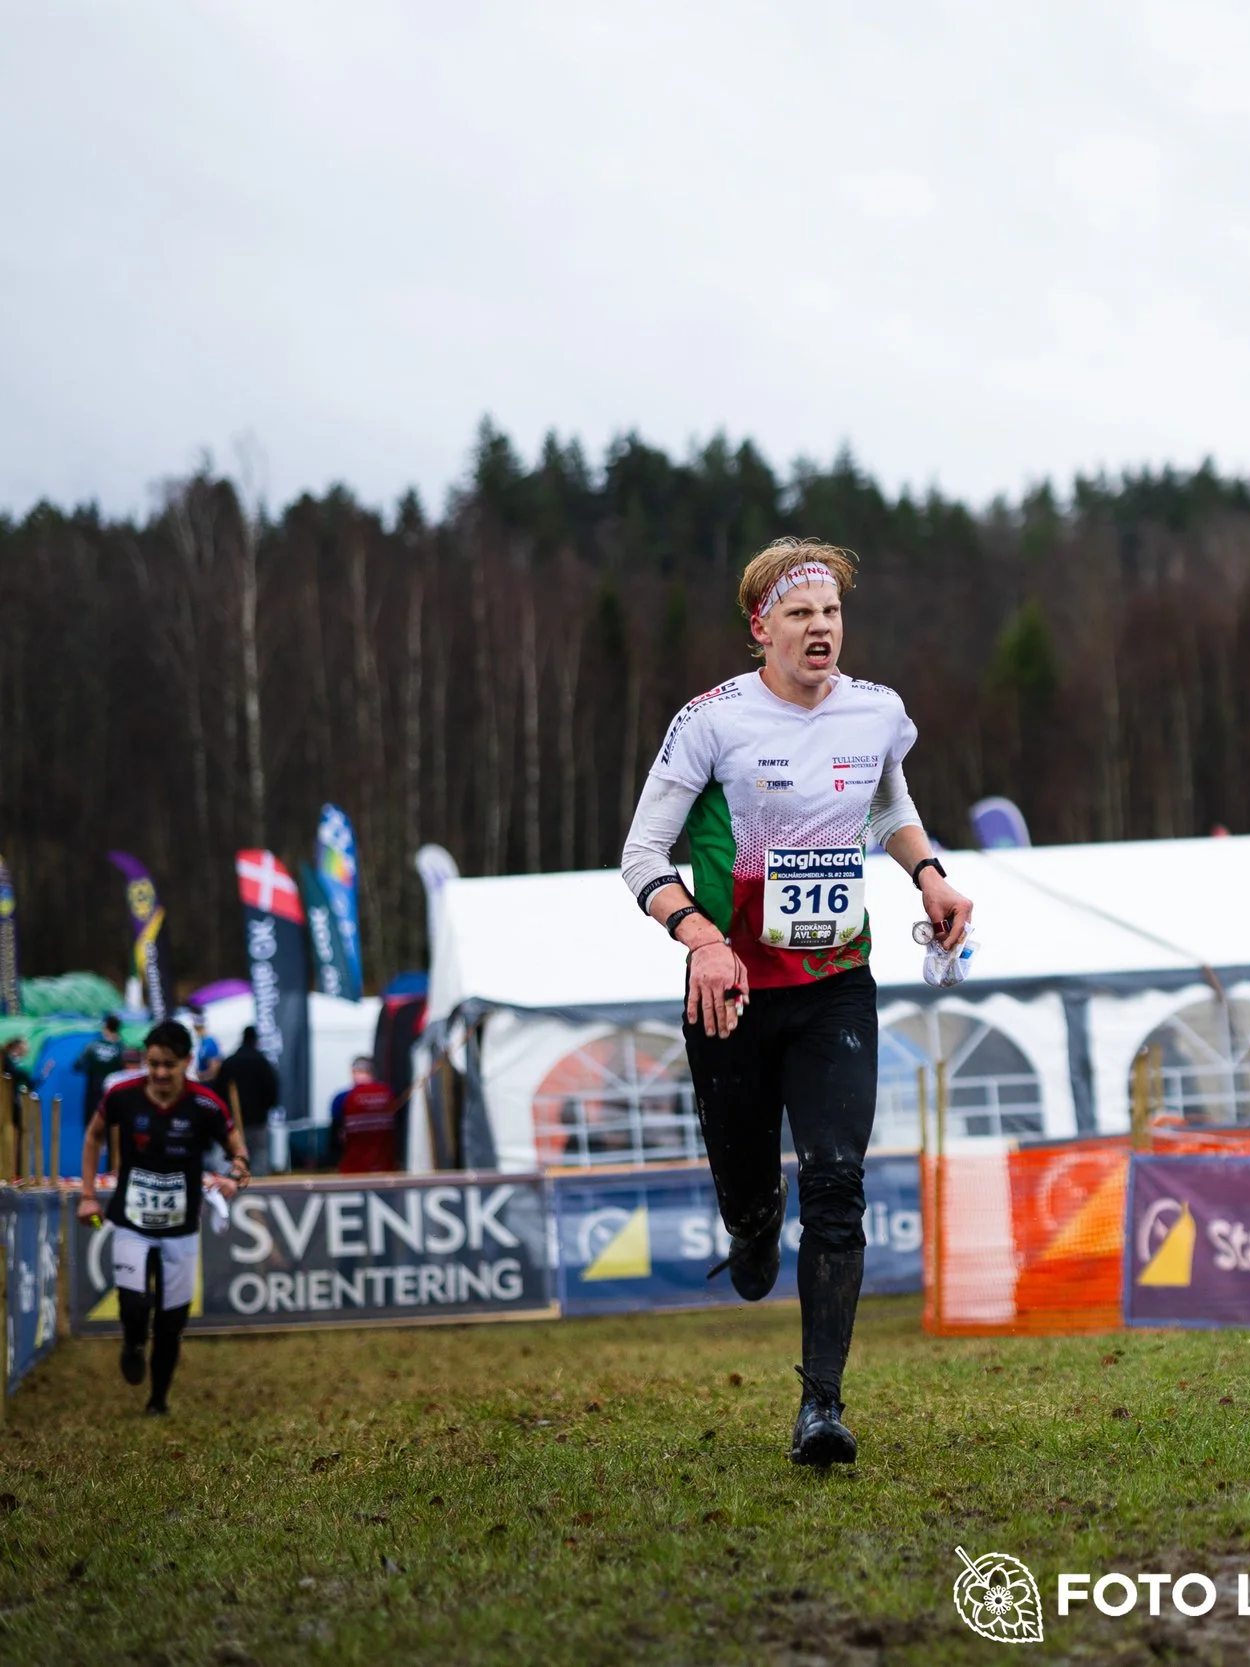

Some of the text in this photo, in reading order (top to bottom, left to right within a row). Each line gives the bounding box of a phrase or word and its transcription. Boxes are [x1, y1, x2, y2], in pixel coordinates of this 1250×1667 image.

[768, 851, 862, 870] bagheera
[780, 884, 849, 914] 316
[794, 923, 832, 931] GODKÄNDA
[137, 1192, 176, 1210] 314
[230, 1184, 521, 1264] SVENSK
[228, 1258, 524, 1315] ORIENTERING
